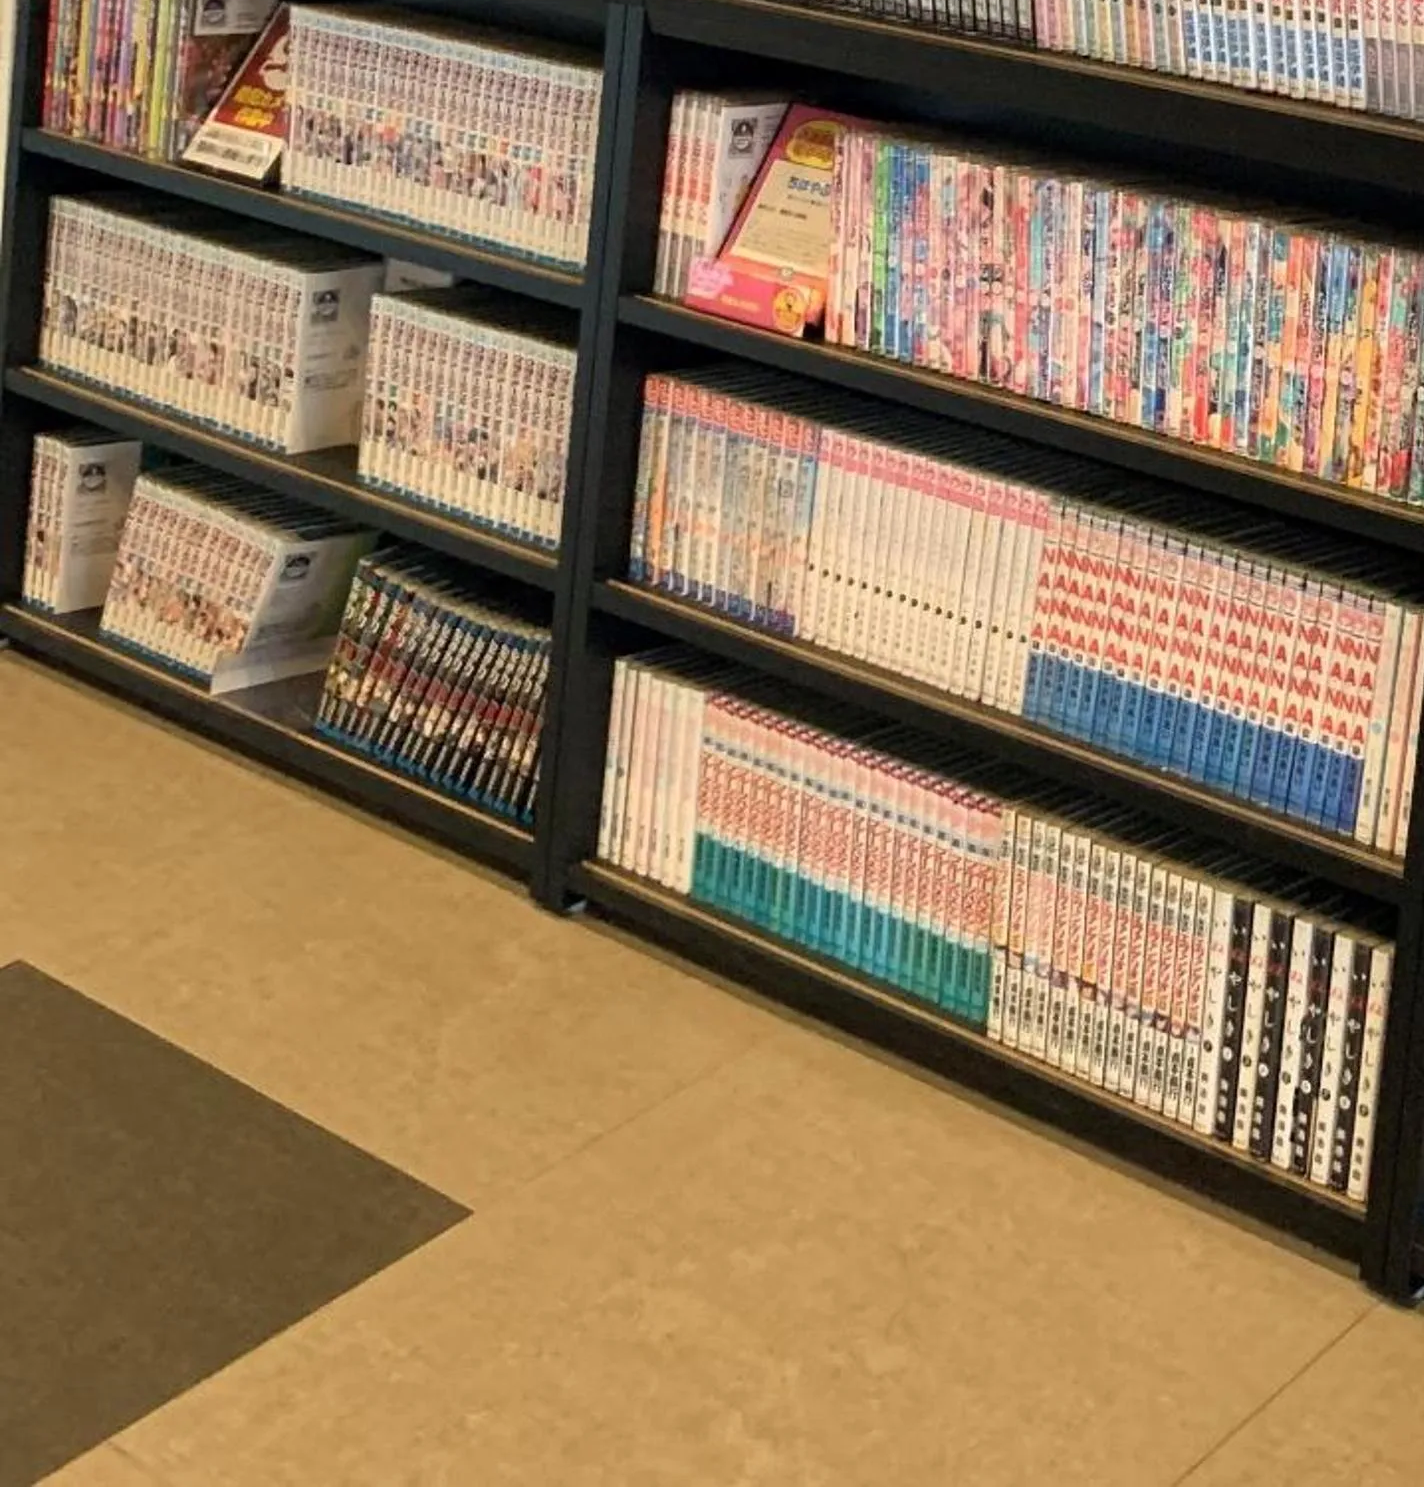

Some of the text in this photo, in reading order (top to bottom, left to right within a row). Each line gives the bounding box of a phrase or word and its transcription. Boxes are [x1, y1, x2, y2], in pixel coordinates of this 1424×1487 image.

[1030, 548, 1056, 638] NANA
[1131, 575, 1158, 669] NANA
[1149, 581, 1175, 677] NANA
[1202, 597, 1227, 692] NANA
[1266, 615, 1294, 714] NANA
[1352, 642, 1380, 741] NANA
